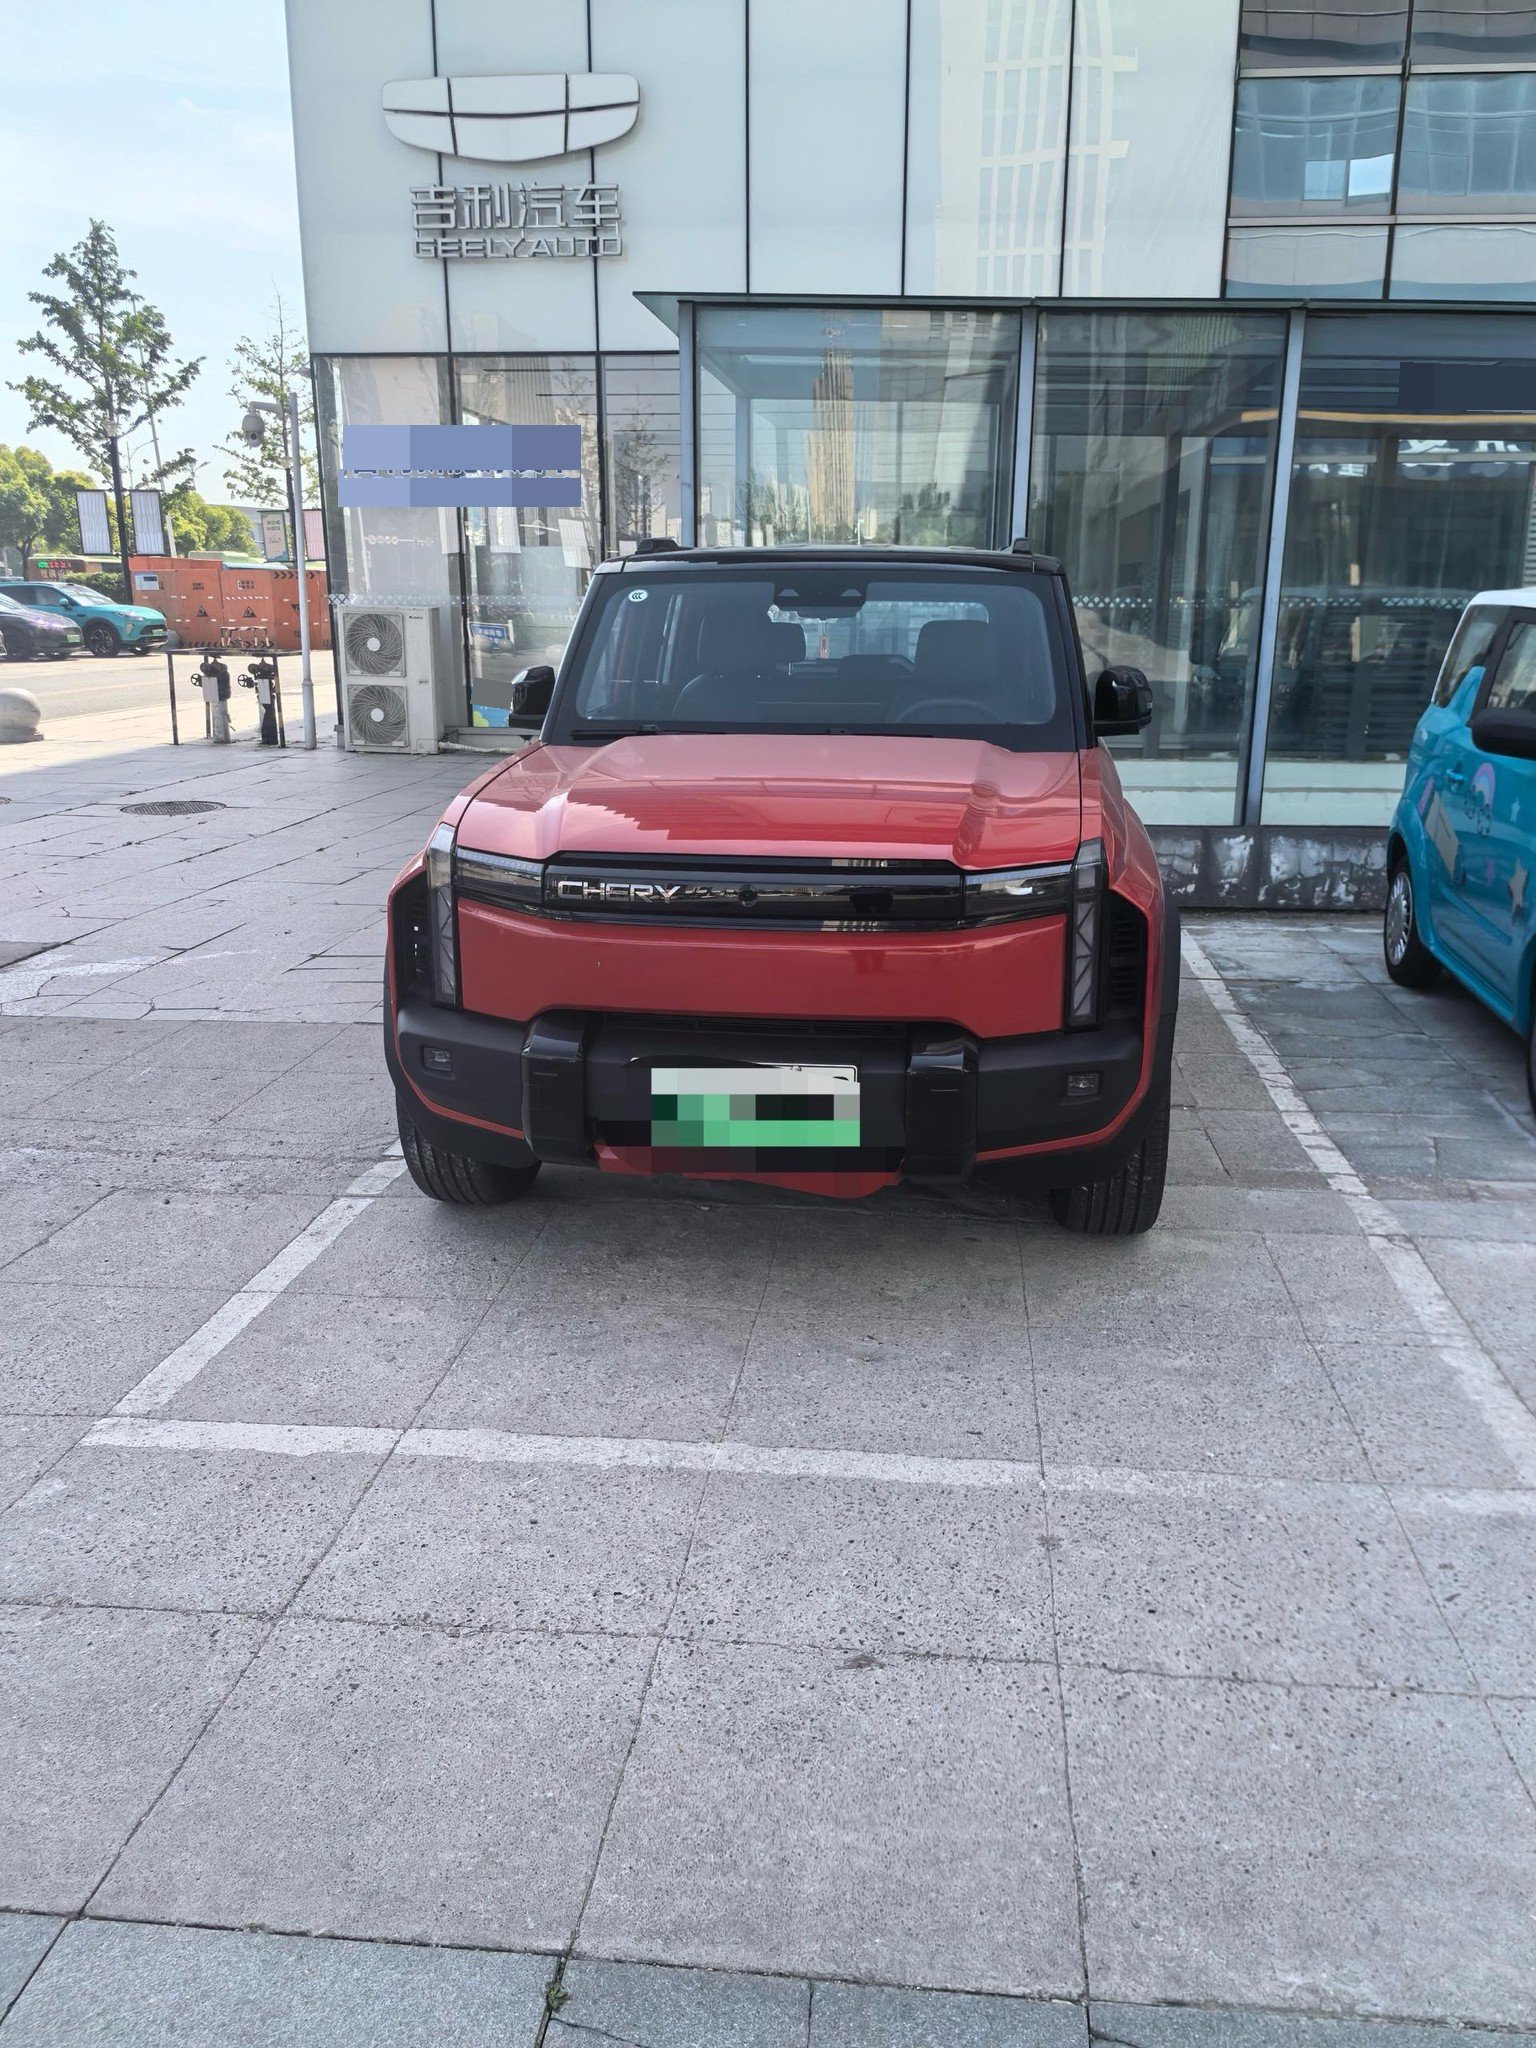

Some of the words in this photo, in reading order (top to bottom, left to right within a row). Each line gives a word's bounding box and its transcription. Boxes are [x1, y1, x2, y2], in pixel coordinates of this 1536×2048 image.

[410, 181, 621, 229] 吉利汽车
[557, 880, 681, 904] CHERY
